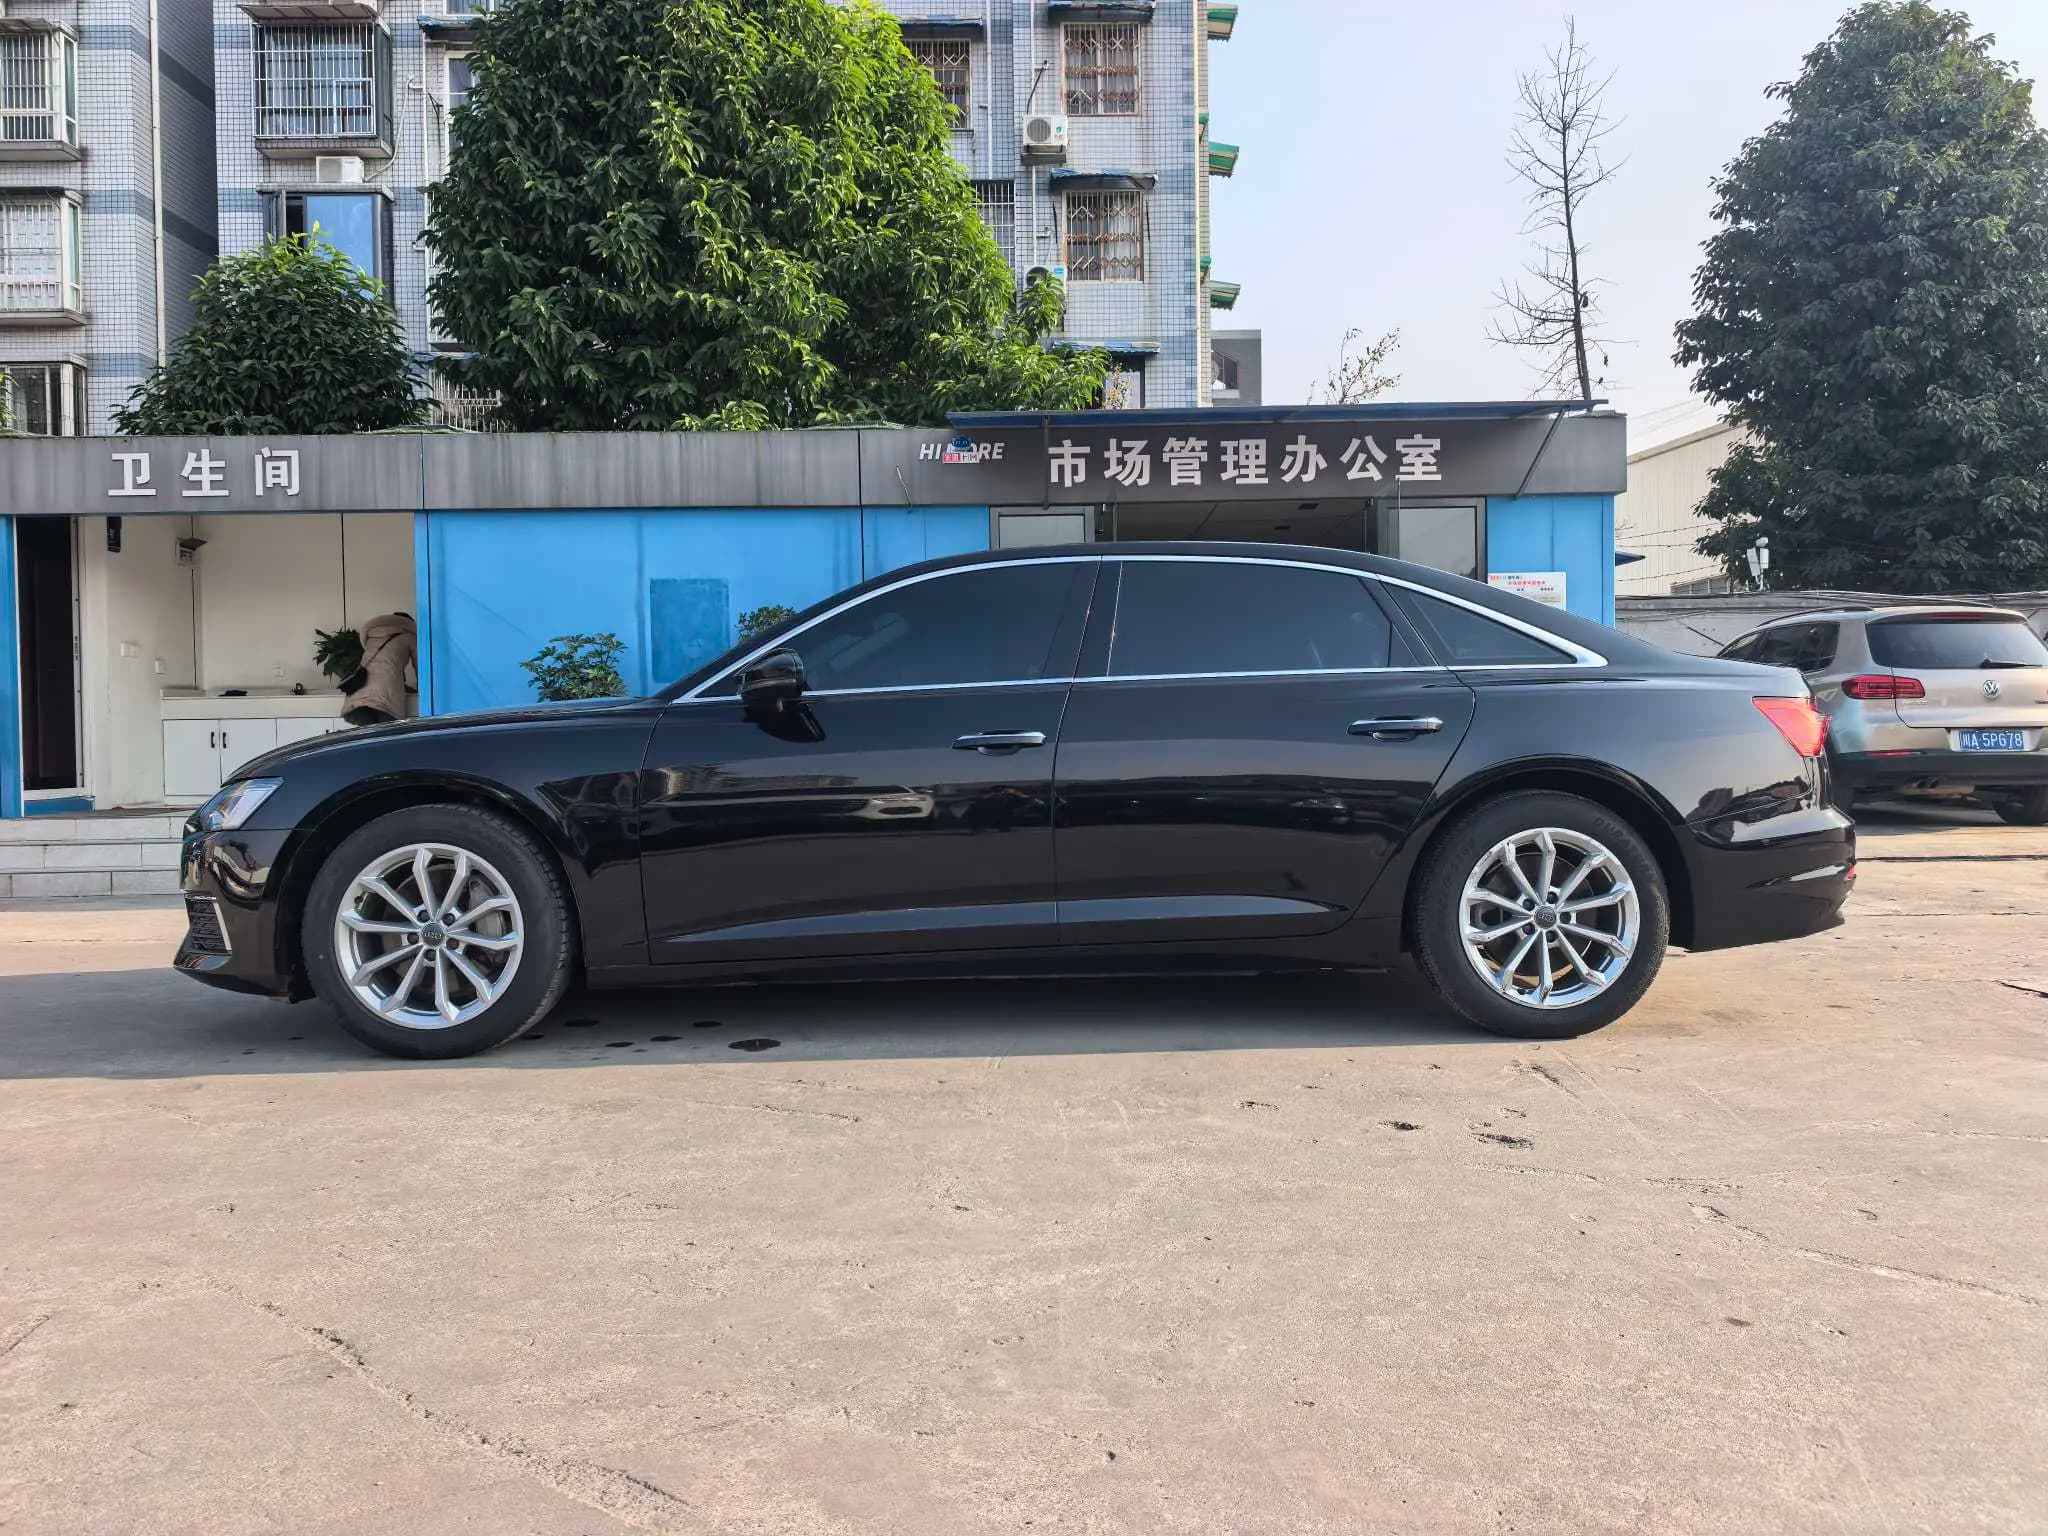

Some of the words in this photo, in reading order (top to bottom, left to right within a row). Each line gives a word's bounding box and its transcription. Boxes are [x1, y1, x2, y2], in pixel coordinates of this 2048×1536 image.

[108, 446, 300, 497] 卫生间
[1048, 433, 1443, 488] 市场管理办公室
